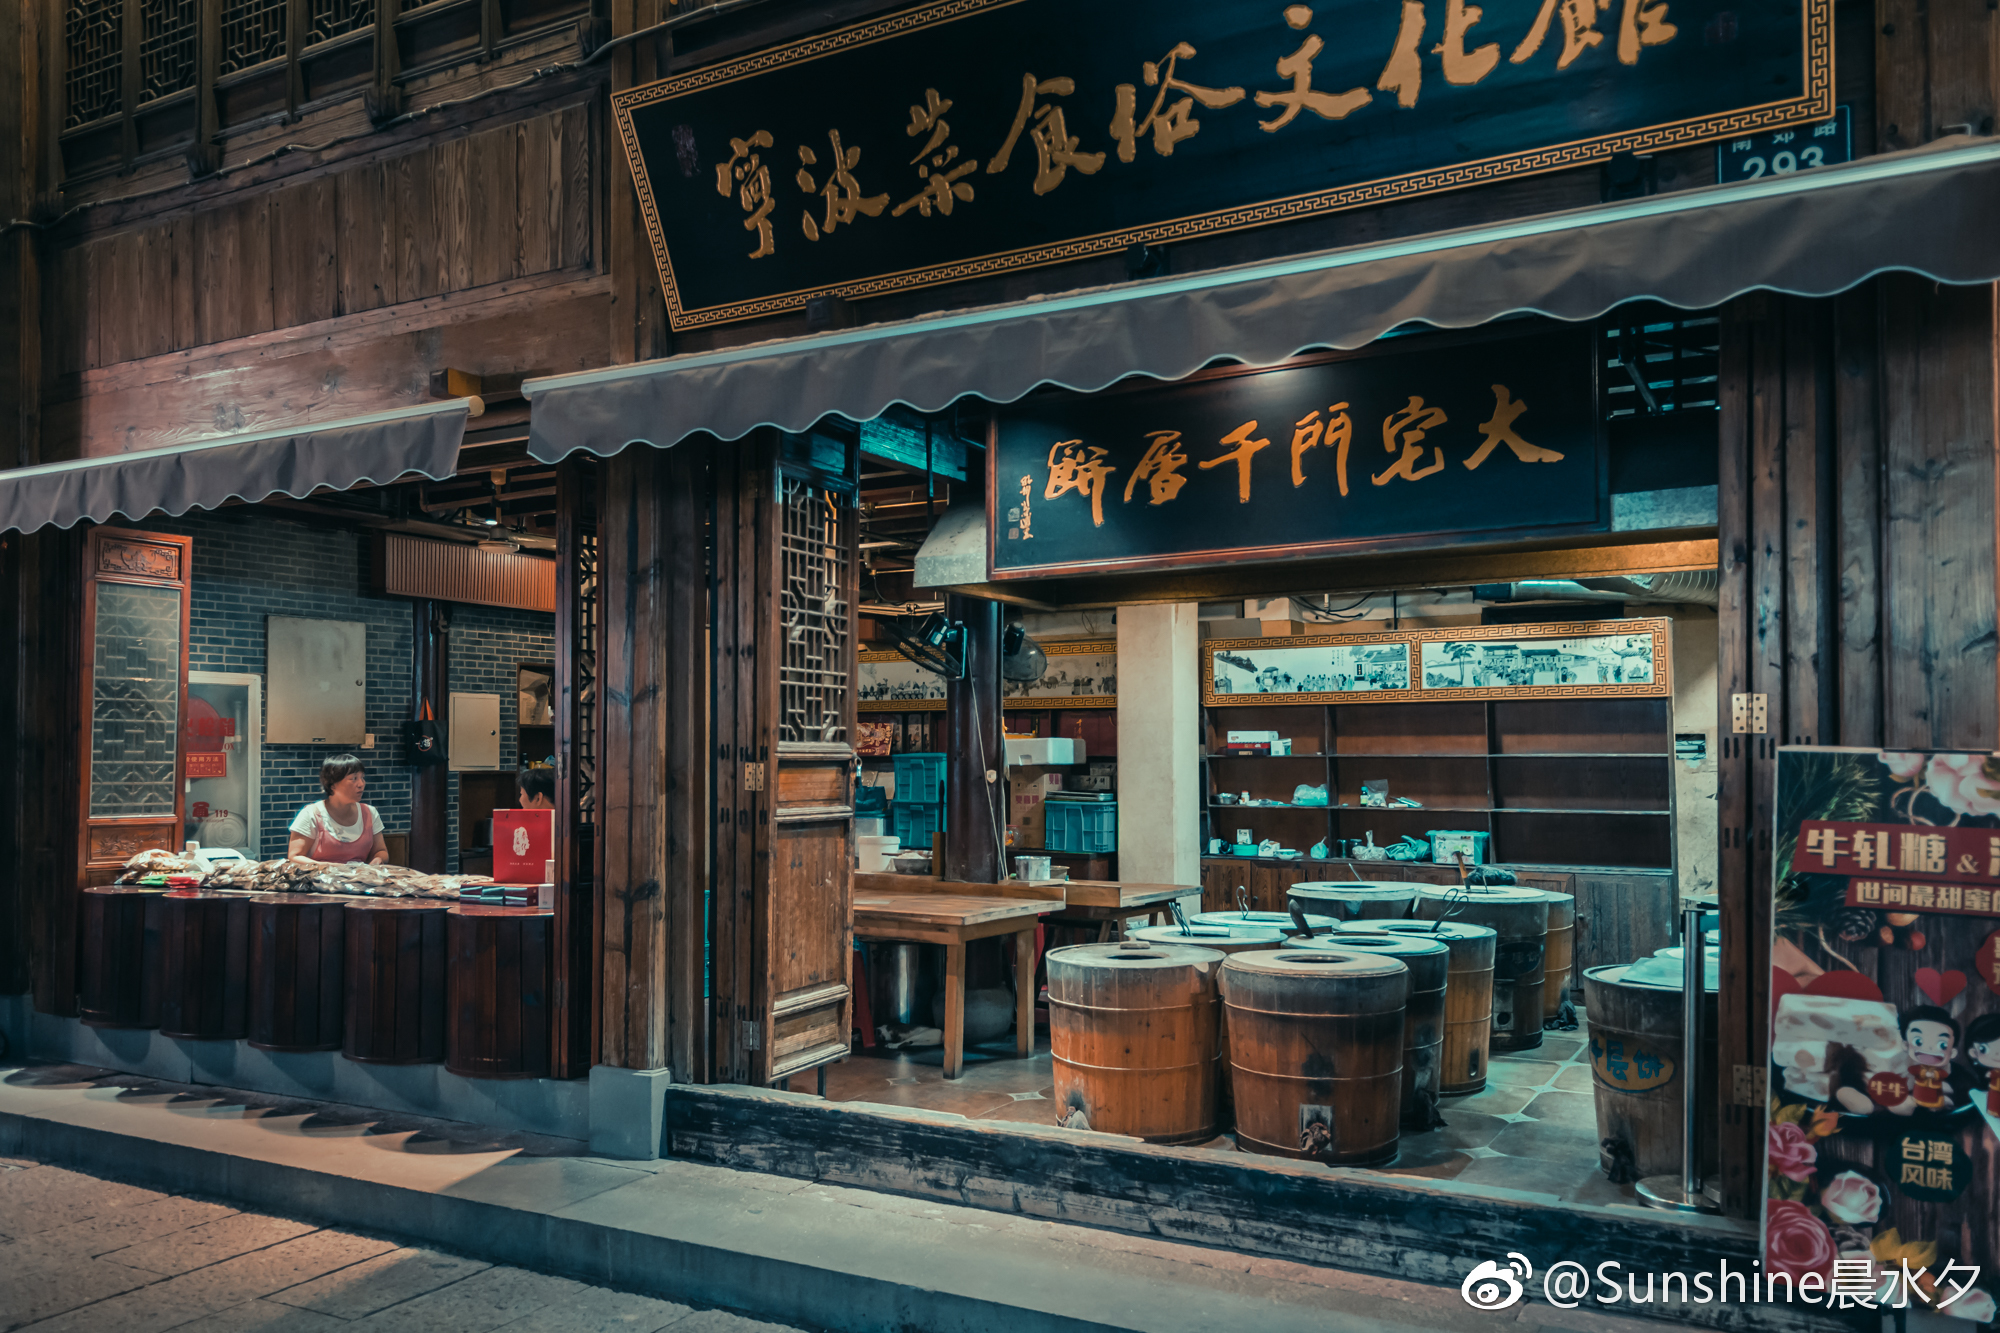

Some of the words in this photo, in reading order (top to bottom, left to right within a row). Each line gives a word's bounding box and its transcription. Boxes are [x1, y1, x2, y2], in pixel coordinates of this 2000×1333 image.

[1742, 145, 1825, 180] 293
[215, 809, 229, 818] 119
[1806, 828, 1947, 874] 牛轧糖
[1956, 853, 1980, 874] &
[1870, 1080, 1906, 1098] 牛牛
[1901, 1136, 1954, 1166] 台湾
[1900, 1163, 1954, 1191] 风味
